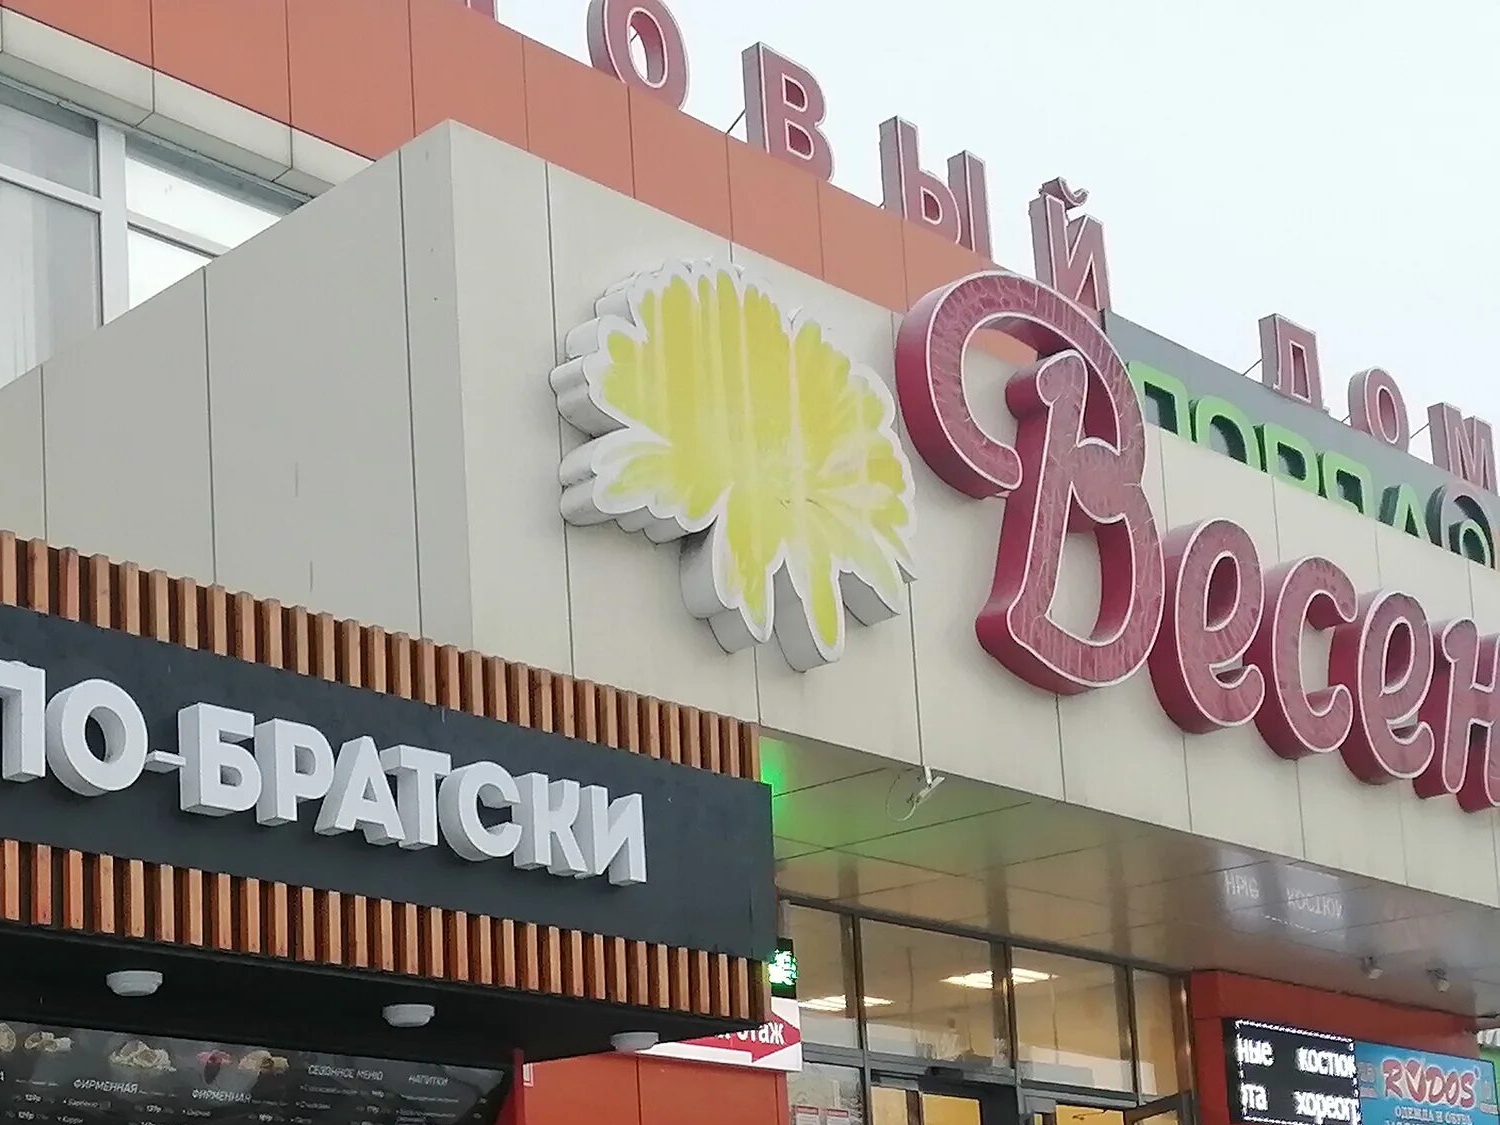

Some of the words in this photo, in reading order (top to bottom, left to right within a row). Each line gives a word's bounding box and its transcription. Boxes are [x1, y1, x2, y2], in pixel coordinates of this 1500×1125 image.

[1260, 313, 1499, 498] ДОМ
[895, 271, 1500, 813] Весен
[73, 1079, 138, 1094] ФИРМЕННАЯ
